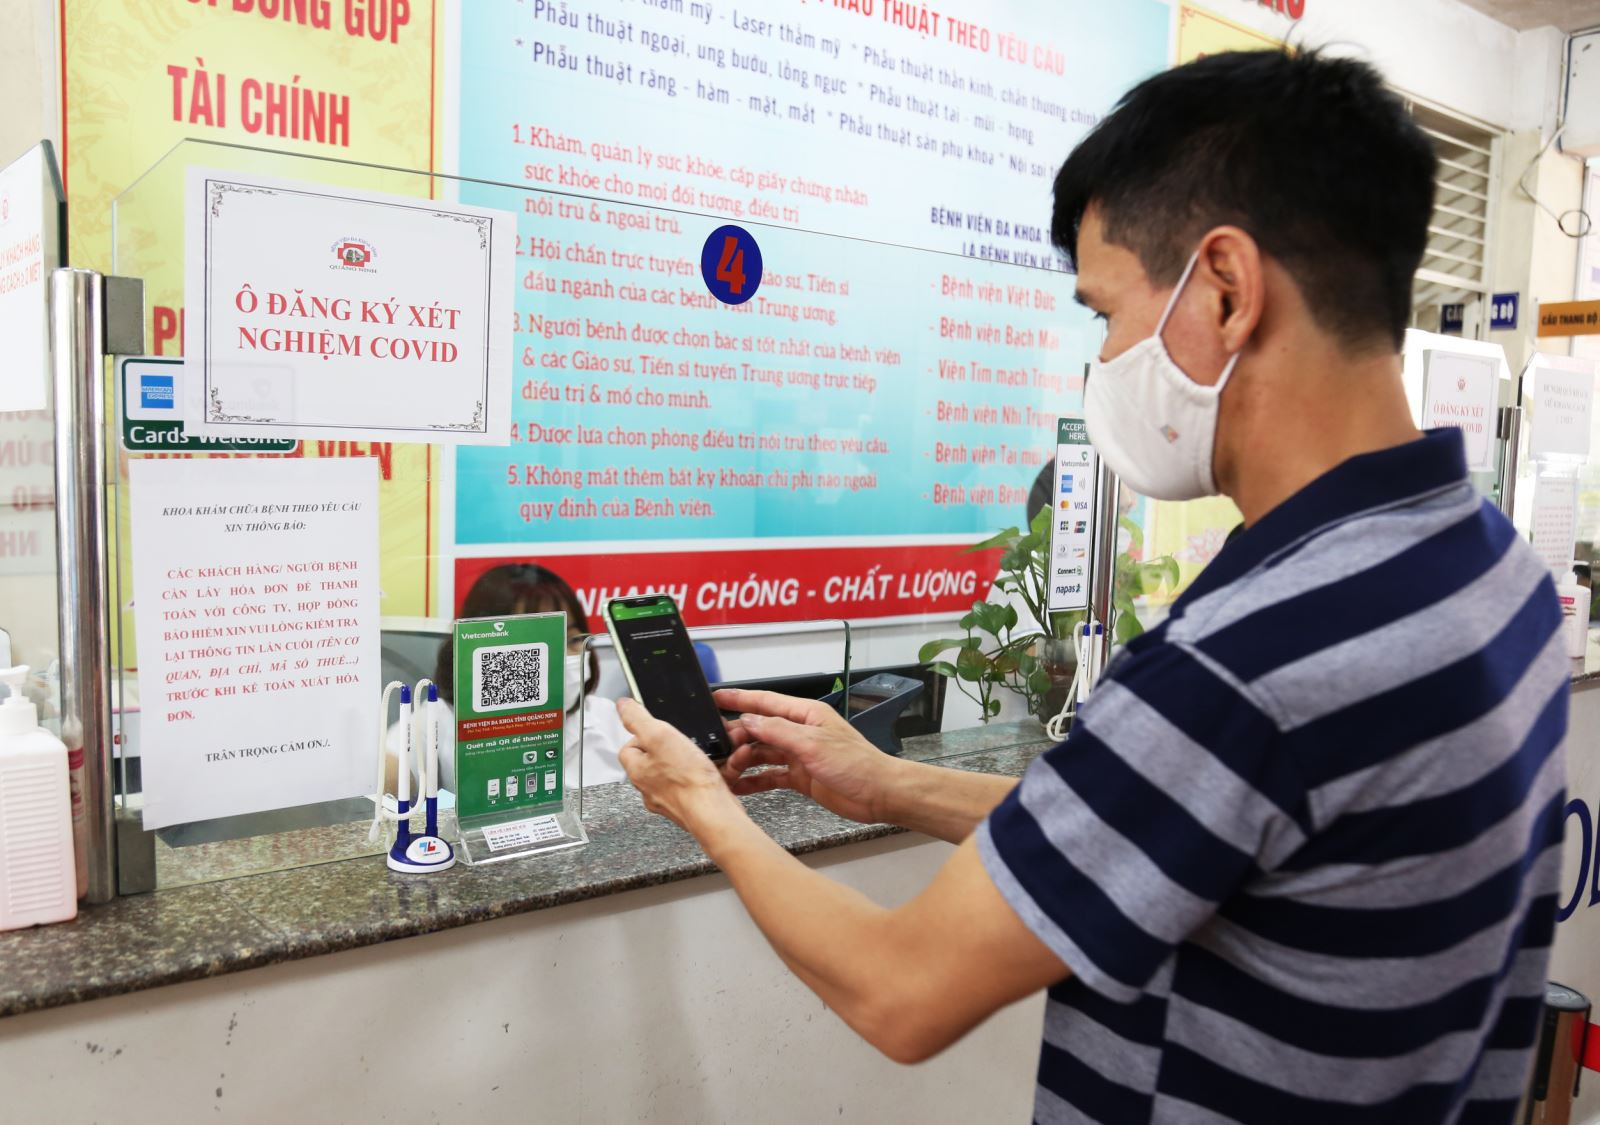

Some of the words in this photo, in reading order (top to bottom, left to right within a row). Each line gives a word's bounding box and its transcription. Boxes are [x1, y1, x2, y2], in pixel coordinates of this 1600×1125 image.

[734, 9, 773, 36] Laser
[947, 16, 990, 53] THEO
[697, 43, 726, 69] ung
[167, 56, 226, 128] TÀI
[241, 75, 349, 147] CHÍNH
[604, 173, 634, 196] cho
[1014, 224, 1042, 244] KHOA
[716, 236, 746, 294] 4
[235, 283, 258, 313] Ô
[267, 289, 352, 321] ĐĂNG
[361, 297, 400, 325] KÝ
[408, 301, 461, 330] XÉT
[238, 326, 361, 360] NGHIỆM
[370, 337, 458, 363] COVID
[970, 361, 992, 384] Tim
[636, 386, 664, 406] cho
[130, 427, 189, 444] Cards
[1069, 432, 1086, 440] HERE
[162, 506, 193, 517] KHOA
[292, 503, 319, 513] THEO
[1074, 502, 1088, 510] VISA
[224, 523, 243, 532] XIN
[245, 522, 281, 532] THÔNG
[320, 580, 358, 590] THANH
[696, 573, 799, 610] CHÓNG
[824, 564, 893, 603] CHẤT
[899, 569, 976, 604] LƯỢNG
[1056, 585, 1075, 595] napas
[226, 625, 247, 636] XIN
[249, 624, 269, 634] VUI
[336, 618, 358, 627] TRA
[461, 630, 509, 640] Vietcombank
[235, 645, 255, 655] TIN
[165, 670, 201, 684] QUAN,
[214, 685, 236, 697] KHI
[523, 734, 542, 742] thanh
